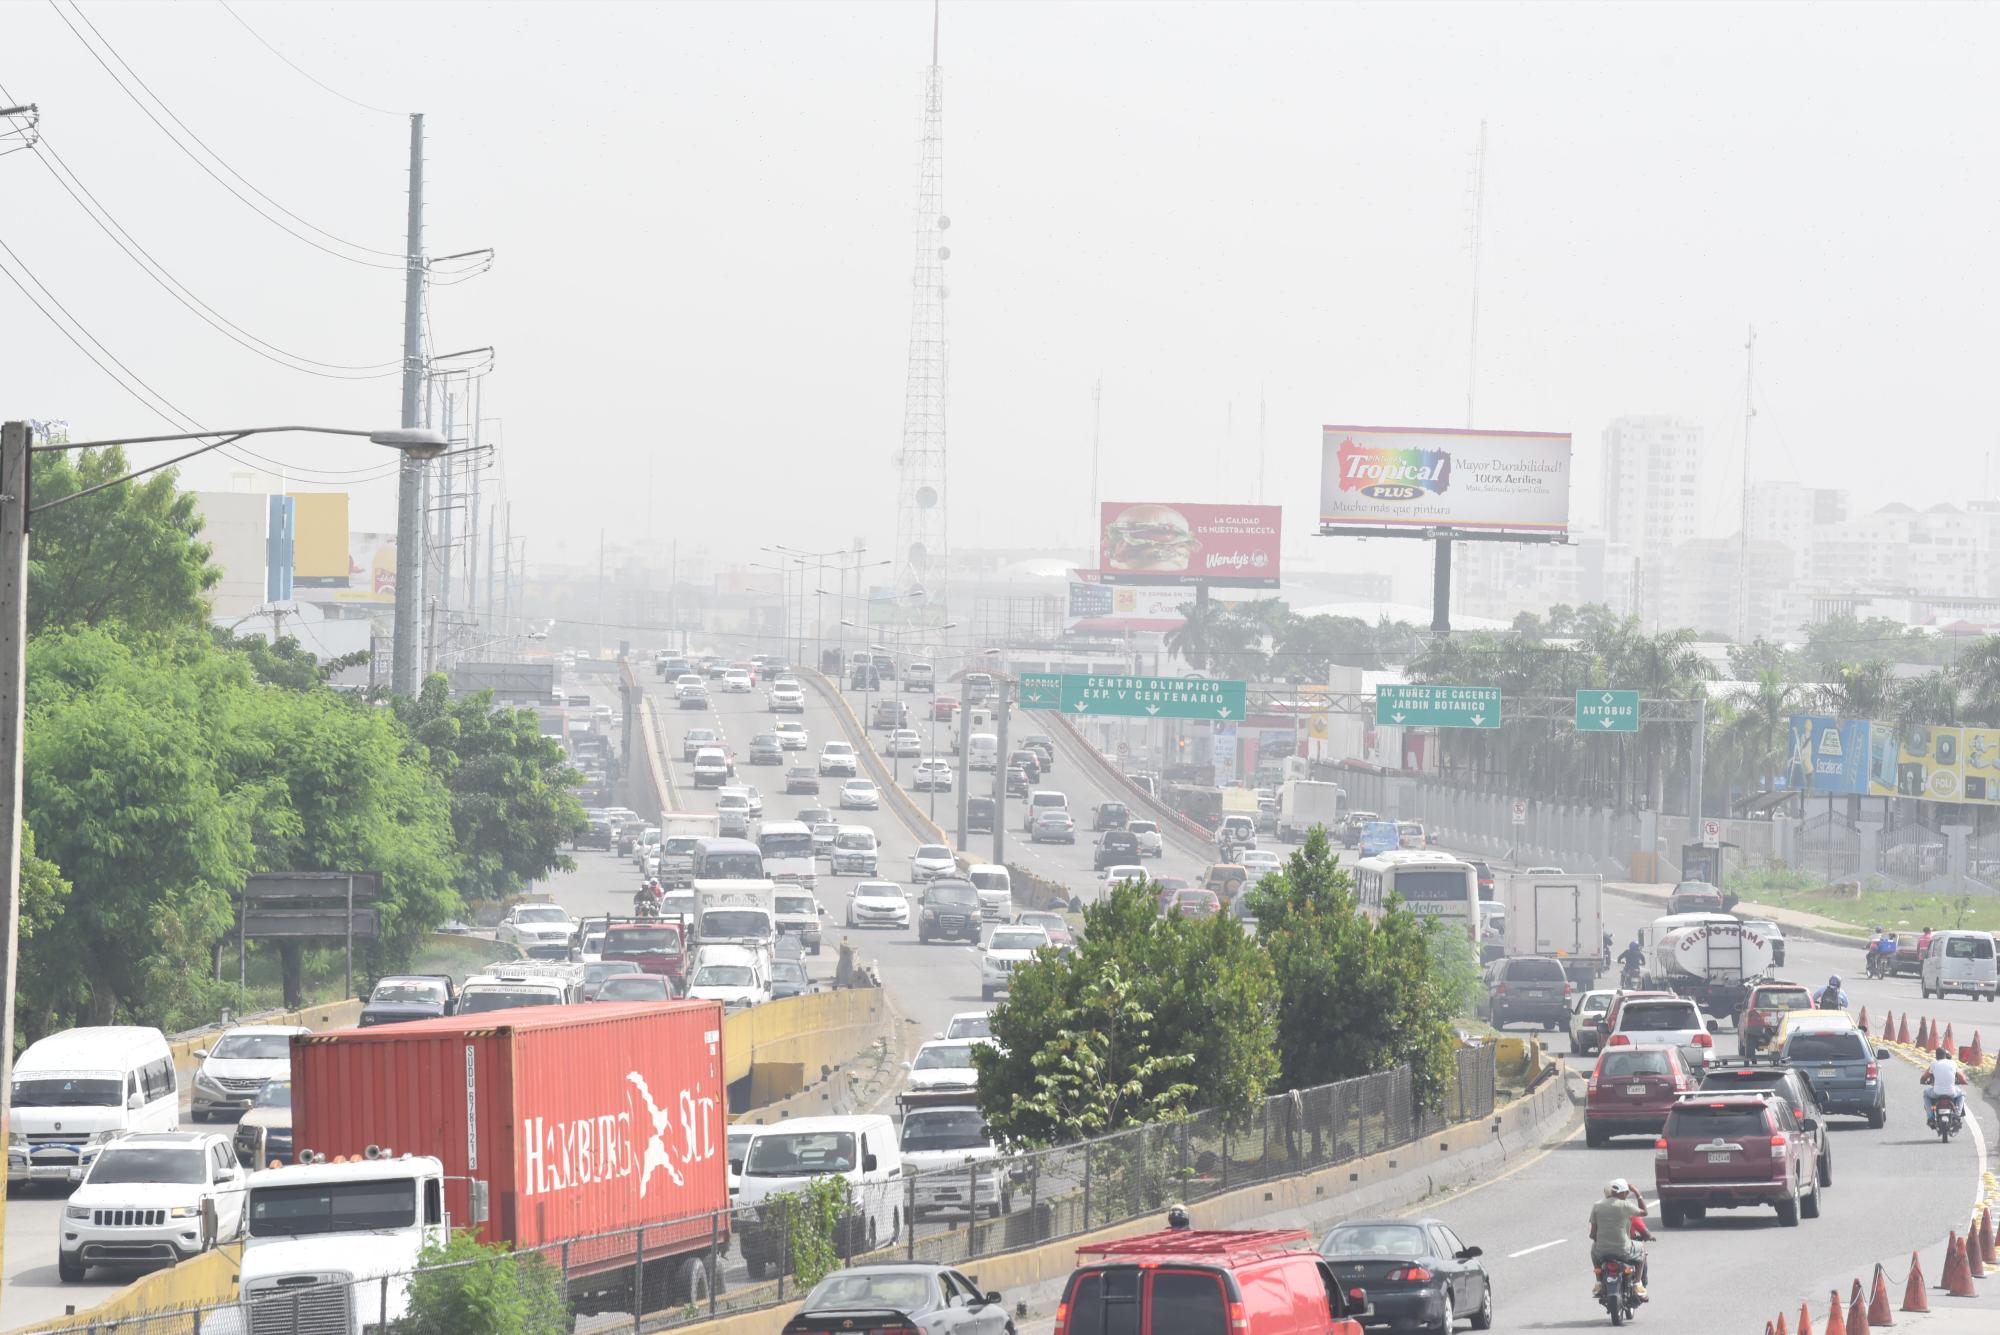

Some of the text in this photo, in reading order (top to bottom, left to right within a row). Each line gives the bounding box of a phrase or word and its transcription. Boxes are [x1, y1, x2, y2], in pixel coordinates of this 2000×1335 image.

[1346, 454, 1445, 484] Tropical
[1456, 459, 1562, 473] Mayor Durabilidad!
[1475, 474, 1503, 484] 100%
[1372, 486, 1414, 498] PLUS
[1332, 501, 1451, 516] Mucho más que pintura
[1225, 517, 1260, 525] CALIDAD
[1198, 526, 1276, 535] ES NUESTRA RECETA
[1206, 551, 1249, 569] Wendy's
[1088, 678, 1221, 693] CENTRO OLIMPICO
[1083, 689, 1224, 704] EXP. V CENTENARIO
[1380, 687, 1395, 698] AV.
[1435, 689, 1447, 699] DE
[1451, 690, 1498, 701] CACERES
[1391, 700, 1486, 711] JARDIN BOTANICO
[1582, 705, 1633, 716] AUTOBUS
[1405, 901, 1444, 914] Metro
[1680, 925, 1722, 951] CRISTO
[1740, 928, 1765, 950] AMA
[524, 1112, 632, 1196] HAMBURG
[470, 1157, 476, 1169] 3
